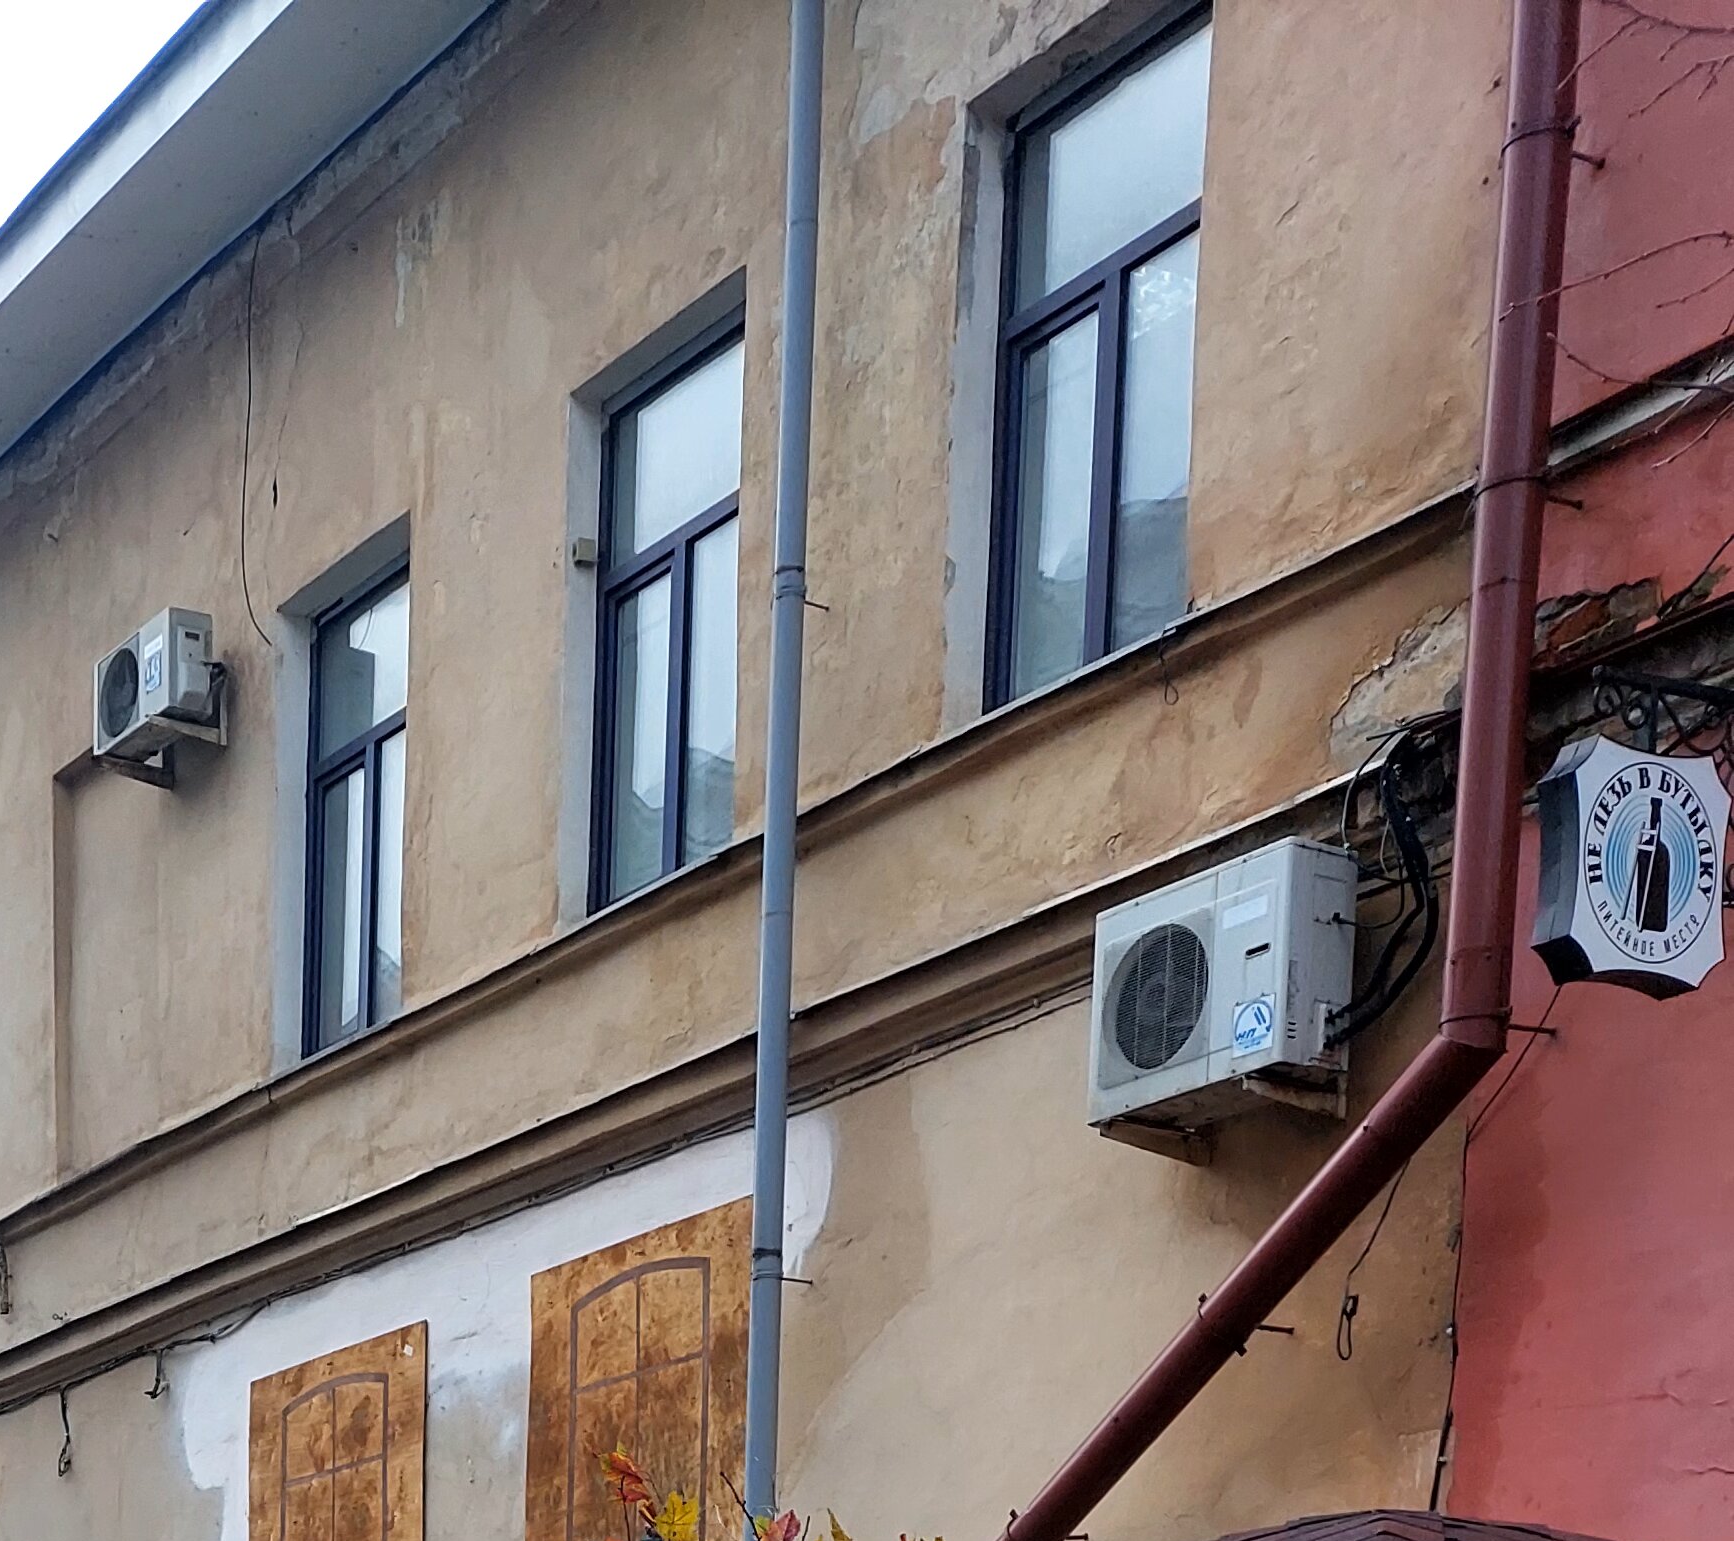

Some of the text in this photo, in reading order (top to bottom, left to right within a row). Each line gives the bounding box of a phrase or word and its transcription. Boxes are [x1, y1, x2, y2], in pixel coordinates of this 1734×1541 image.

[1586, 767, 1716, 903] НЕ ЛЕЗЬ В БУТЫЛКУ
[1597, 900, 1701, 957] ПИТЕЙНОЕ МЕСТО
